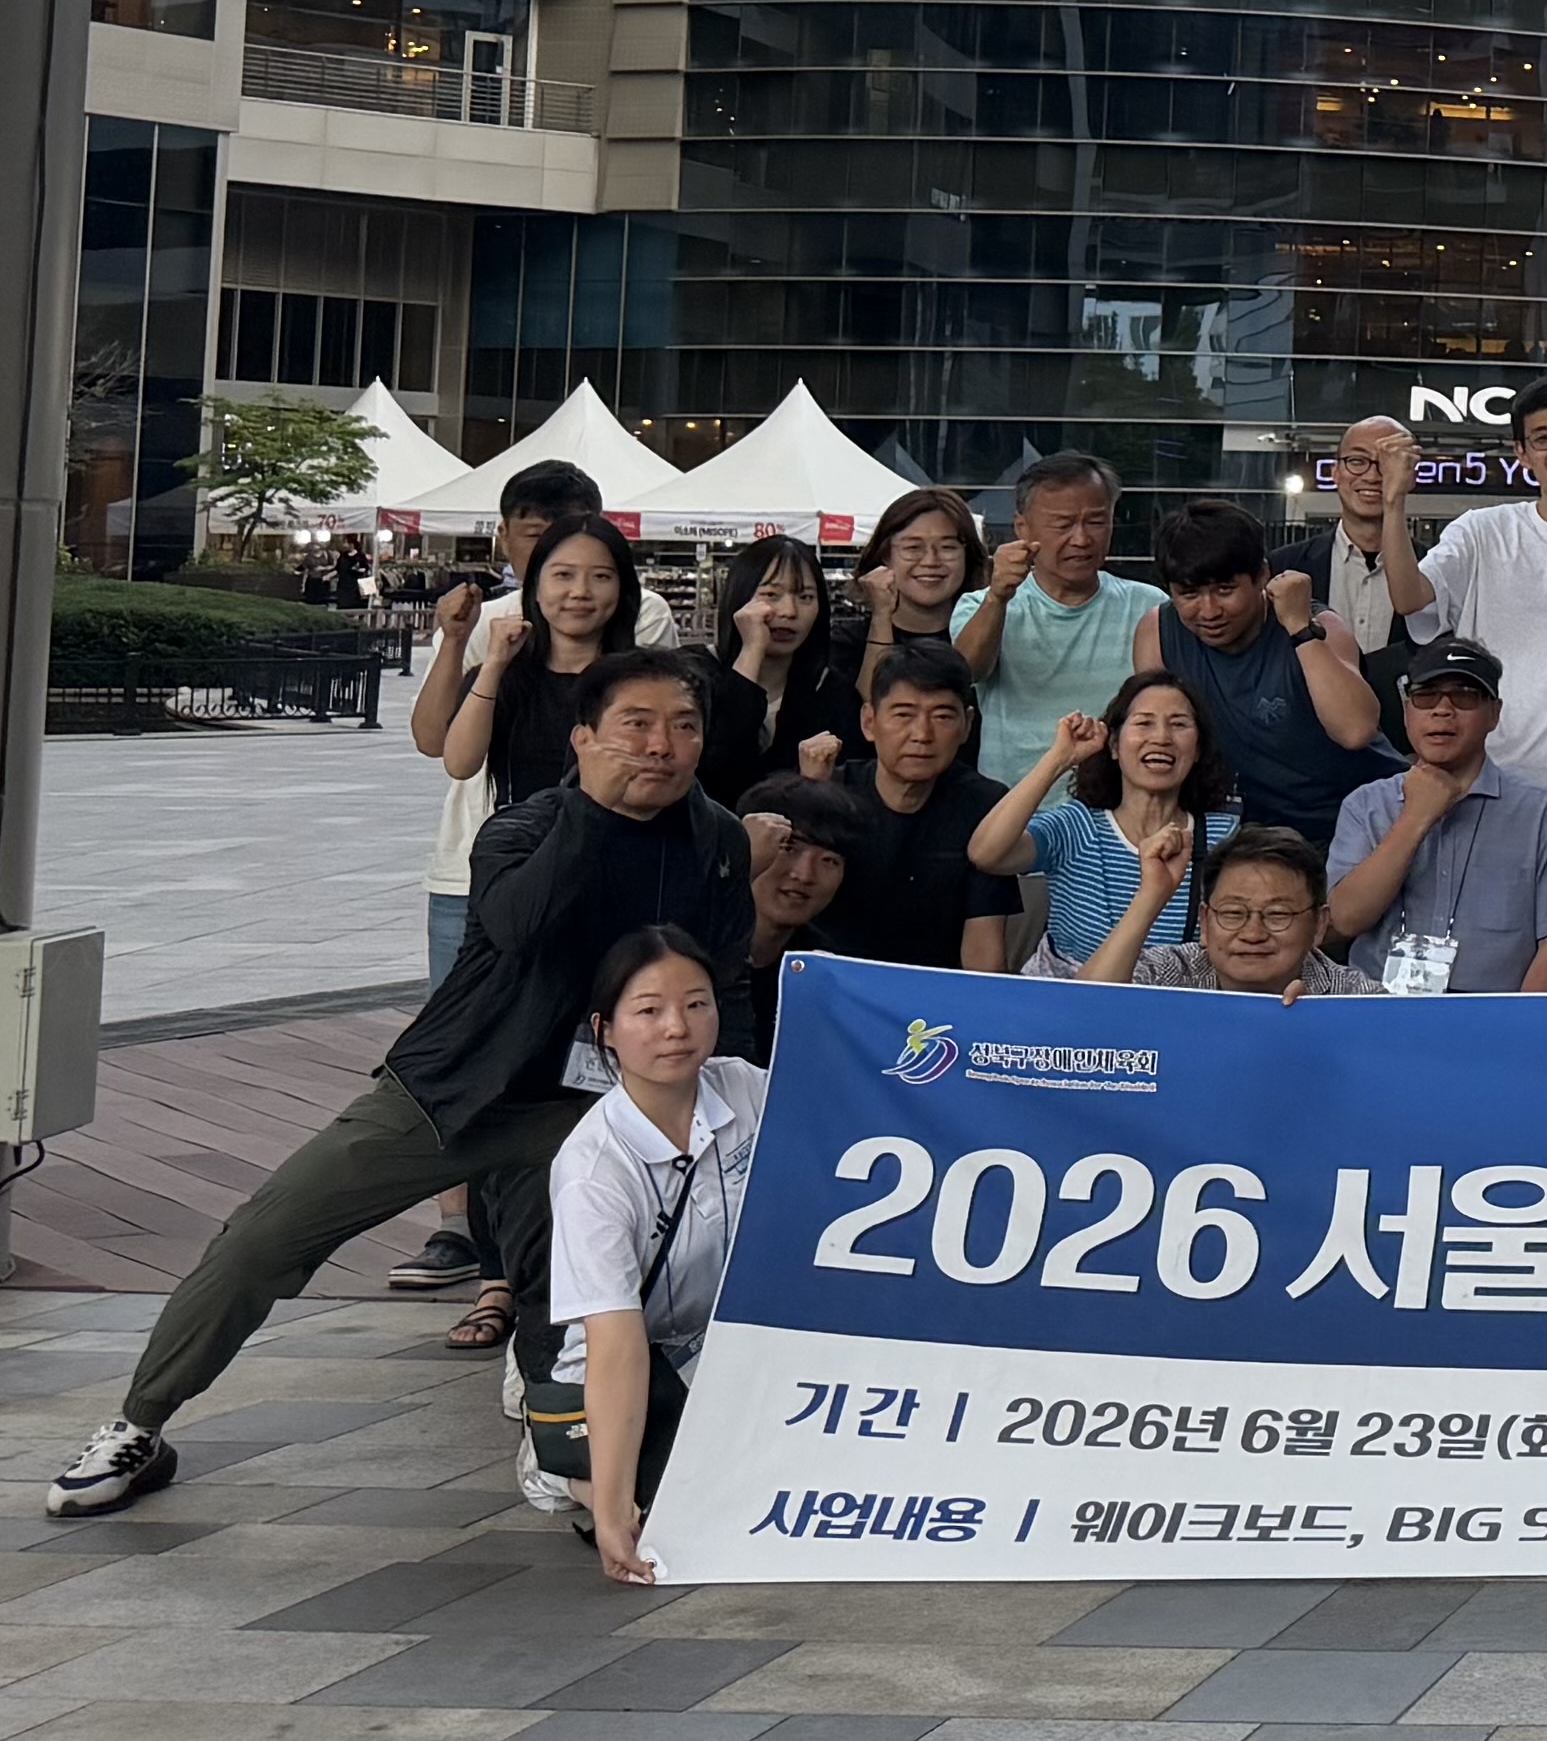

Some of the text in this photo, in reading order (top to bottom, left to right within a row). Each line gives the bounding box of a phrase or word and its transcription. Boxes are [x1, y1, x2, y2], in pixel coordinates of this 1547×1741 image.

[1316, 453, 1487, 490] gen5
[968, 1042, 1159, 1075] 성북구장애인체육회
[814, 1137, 1265, 1299] 2026
[785, 1383, 920, 1439] 기간
[998, 1398, 1229, 1453] 2026년
[1241, 1409, 1339, 1456] 6월
[749, 1491, 986, 1542] 사업내용
[1071, 1501, 1363, 1548] 웨이크보드,
[1386, 1507, 1502, 1541] BIG
